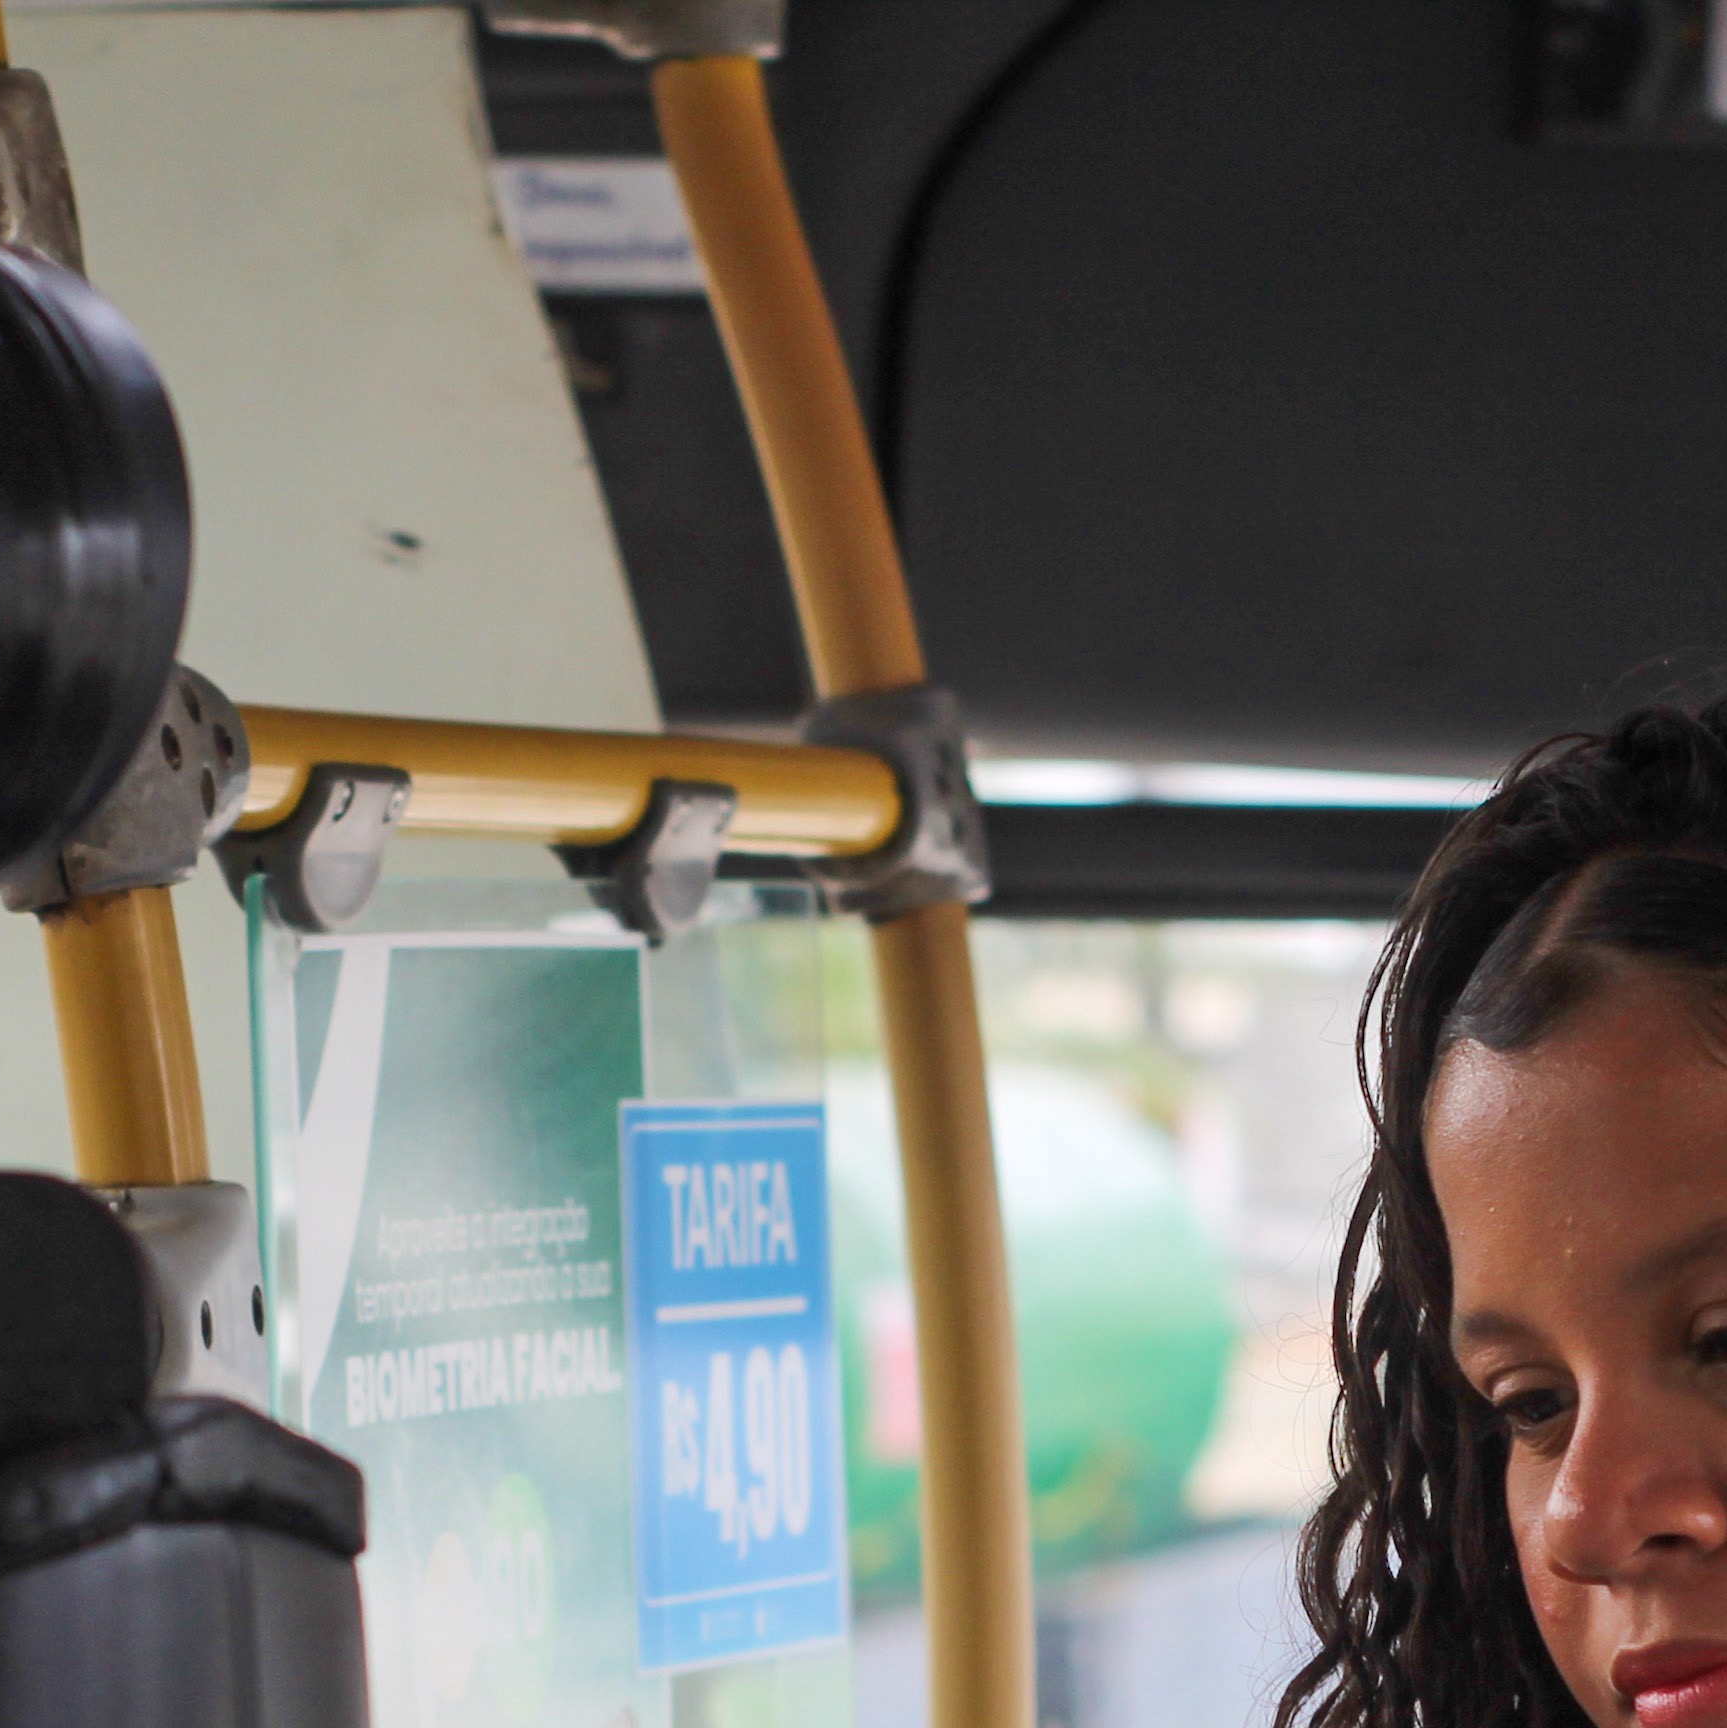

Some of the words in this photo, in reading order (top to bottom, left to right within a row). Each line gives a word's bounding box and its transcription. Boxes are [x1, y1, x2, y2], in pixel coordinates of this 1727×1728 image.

[663, 1161, 798, 1271] TARIFA
[357, 1265, 444, 1333] temporal
[345, 1335, 510, 1428] BIOMETRIA
